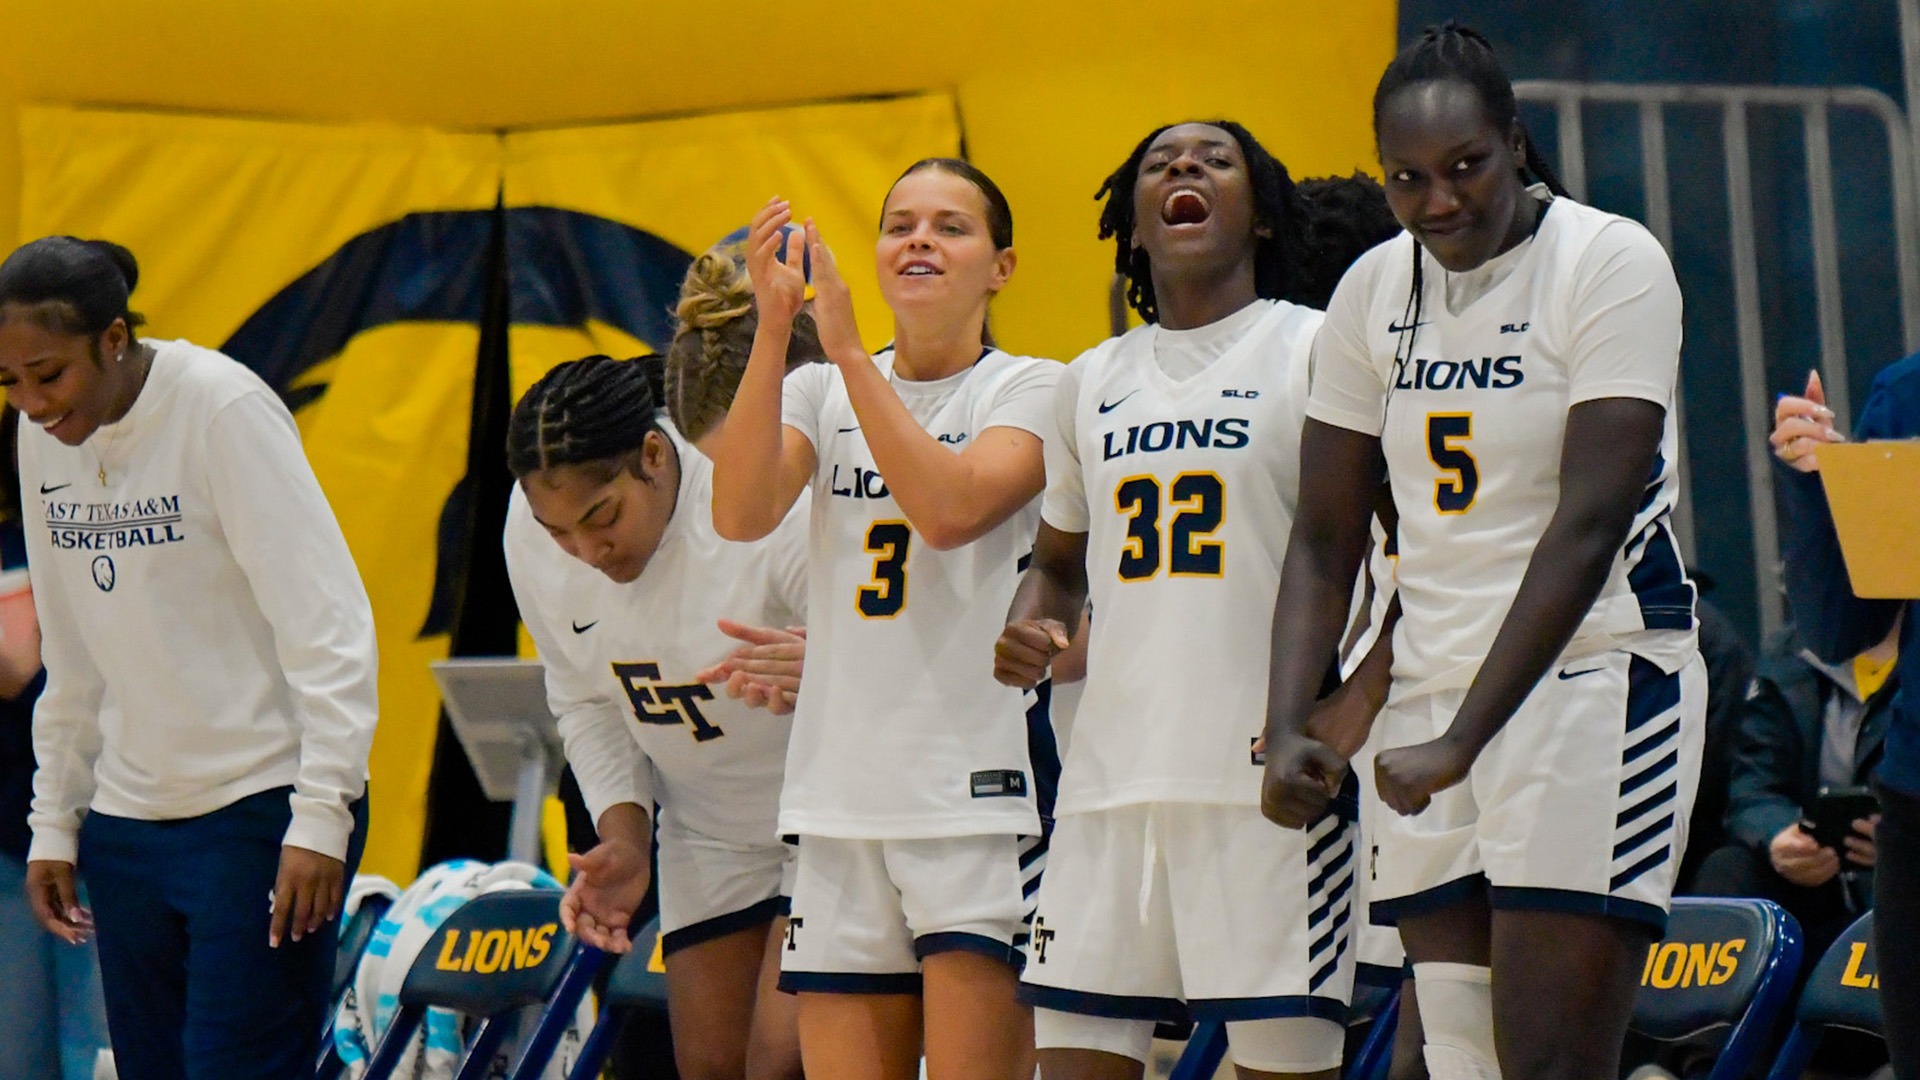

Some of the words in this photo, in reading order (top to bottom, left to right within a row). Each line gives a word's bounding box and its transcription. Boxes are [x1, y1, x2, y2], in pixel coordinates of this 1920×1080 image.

[1221, 390, 1260, 399] SLC
[1395, 355, 1524, 390] LIONS
[1103, 418, 1249, 462] LIONS
[1425, 411, 1481, 516] 5
[832, 464, 890, 499] LIO
[44, 499, 81, 520] AST
[87, 502, 130, 521] TEXAS
[131, 495, 180, 518] A&M
[1113, 470, 1226, 583] 32
[51, 525, 184, 550] ASKETBALL
[854, 519, 912, 620] 3
[610, 660, 725, 743] ET
[436, 923, 558, 974] LIONS
[1640, 939, 1746, 989] IONS
